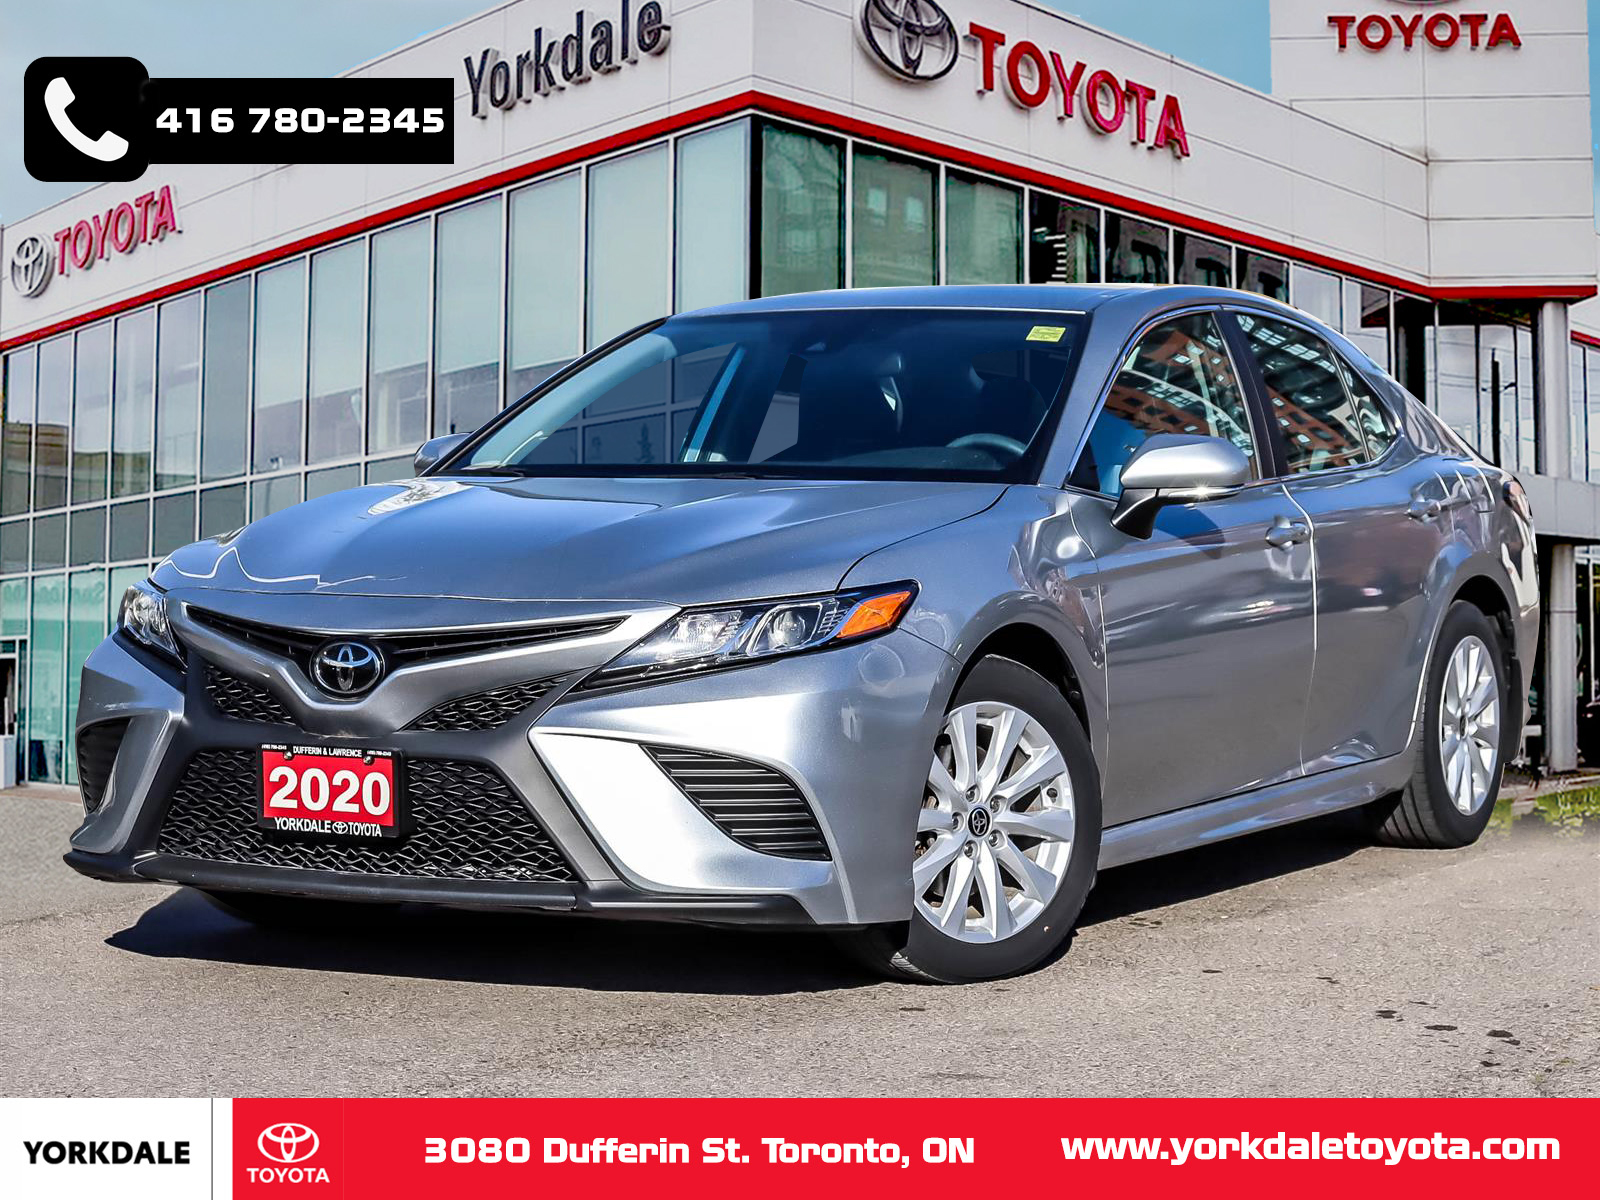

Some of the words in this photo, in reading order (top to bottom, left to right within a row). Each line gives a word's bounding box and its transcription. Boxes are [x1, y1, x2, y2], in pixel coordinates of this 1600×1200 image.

[1327, 13, 1522, 50] TOYOTA
[463, 0, 672, 119] Yorkdale
[967, 22, 1190, 158] TOYOTA
[54, 185, 177, 276] TOYOTA
[293, 746, 321, 755] DUFFERIN
[329, 748, 362, 757] LAWRENCE
[269, 766, 390, 816] 2020
[274, 817, 331, 833] YORKDALE
[348, 822, 382, 837] TOYOTA
